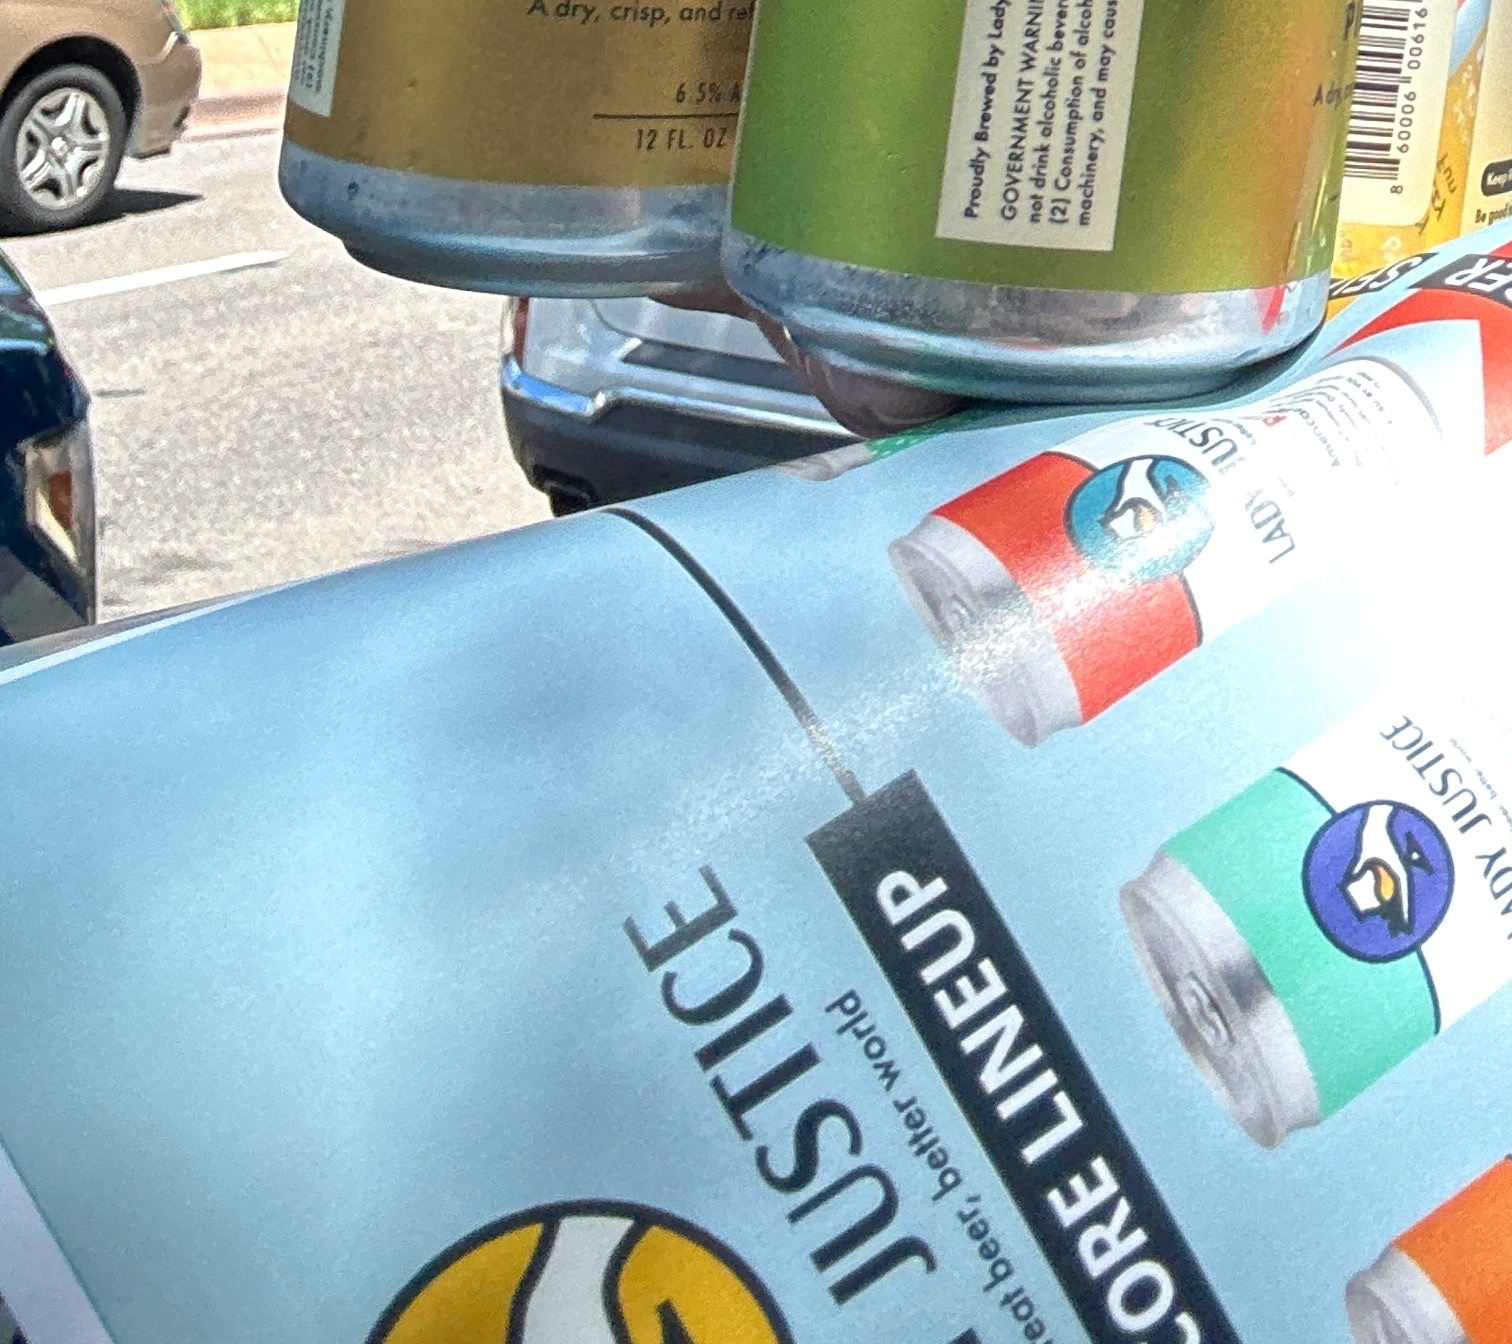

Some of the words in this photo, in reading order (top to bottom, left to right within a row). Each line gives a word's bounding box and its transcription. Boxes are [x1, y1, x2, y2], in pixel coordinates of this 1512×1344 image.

[608, 0, 671, 28] crisp,
[678, 0, 724, 26] and
[982, 43, 1005, 68] by
[1068, 50, 1087, 70] of
[1097, 44, 1117, 82] may
[1396, 91, 1417, 154] 60006
[1407, 8, 1428, 70] 00616
[973, 71, 998, 142] Brewed
[1037, 57, 1062, 139] alcoholic
[1054, 75, 1084, 192] Consumption
[1092, 87, 1107, 123] and
[636, 128, 658, 151] 12
[666, 128, 694, 151] FL.
[703, 128, 729, 149] OZ
[1000, 77, 1034, 222] GOVERNMENT
[1030, 143, 1050, 190] drink
[1078, 128, 1106, 226] machinery,
[963, 146, 992, 219] Proudly
[1029, 193, 1044, 224] not
[1049, 198, 1072, 225] (2)
[1380, 715, 1493, 835] JUSTICE
[824, 989, 901, 1093] world
[876, 870, 1084, 1164] LINEUP
[624, 872, 938, 1306] JUSTICE
[892, 1096, 963, 1202] better
[956, 1194, 1015, 1294] beer,
[1046, 1156, 1201, 1344] ORE
